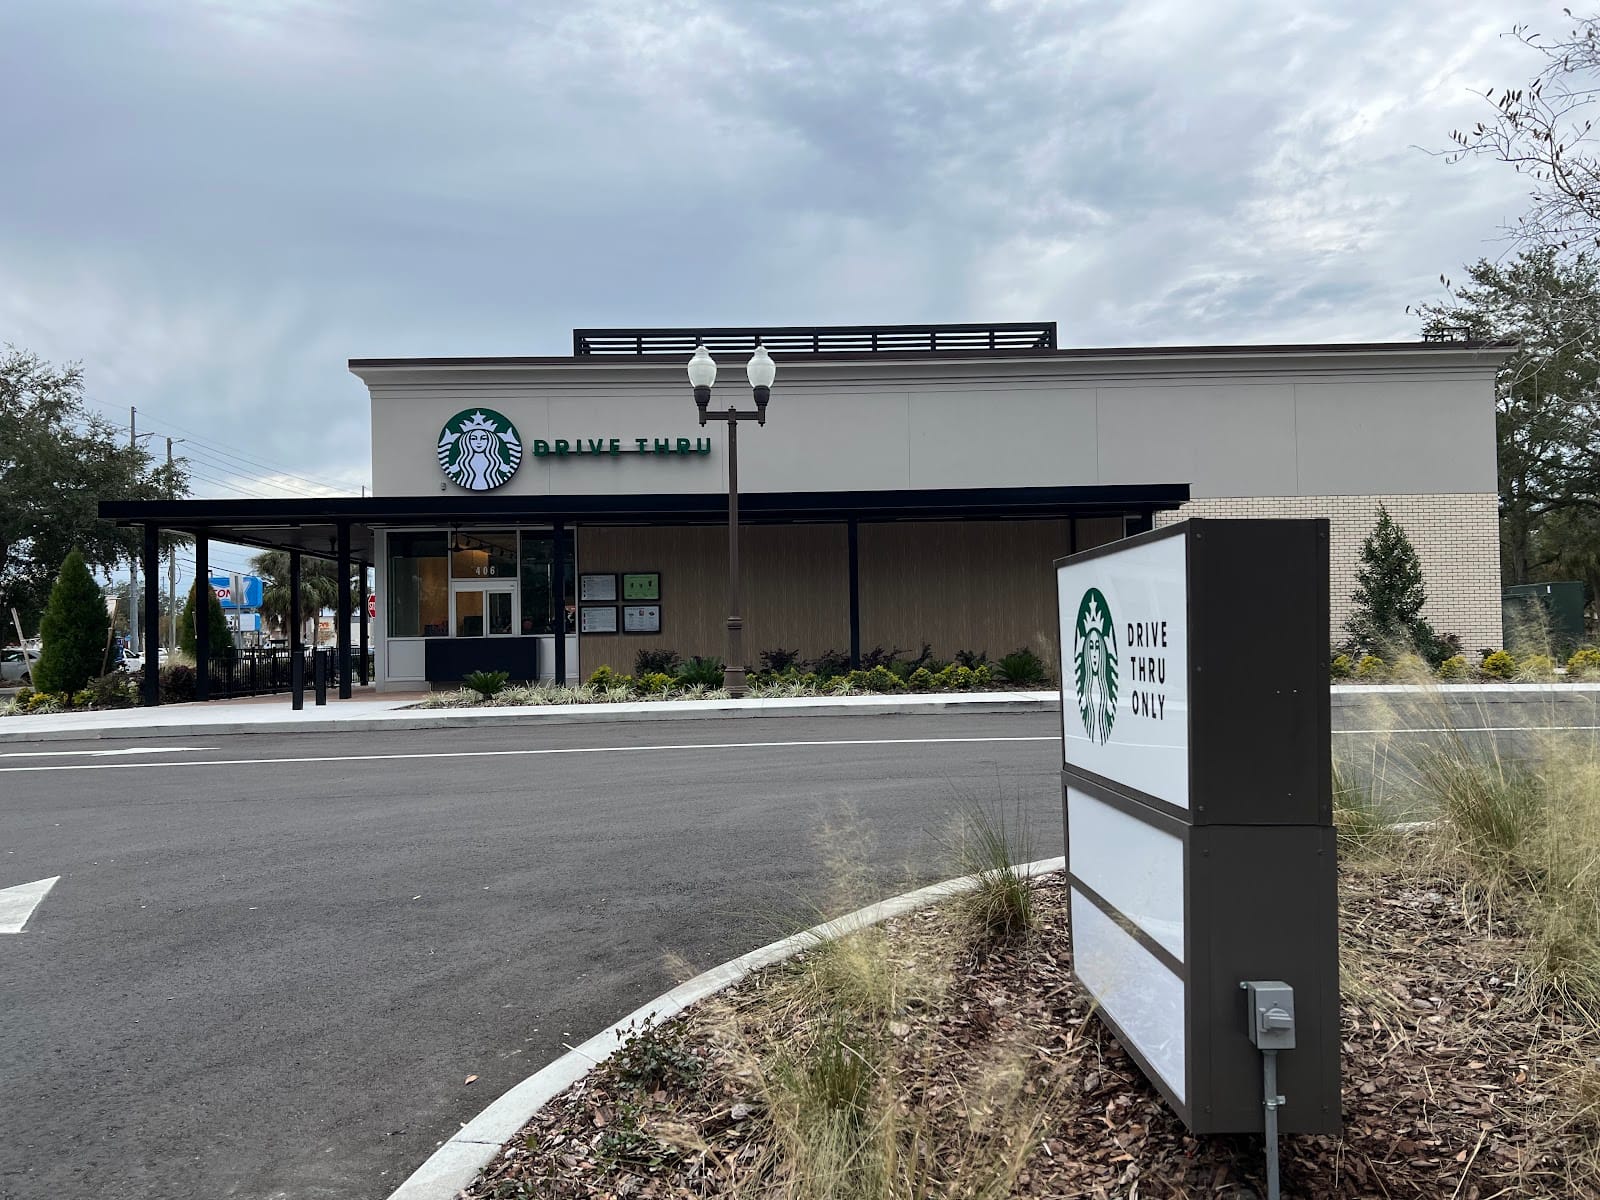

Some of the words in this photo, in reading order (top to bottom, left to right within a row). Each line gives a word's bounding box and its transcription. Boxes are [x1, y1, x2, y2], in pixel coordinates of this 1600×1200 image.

[533, 439, 620, 457] DRIVE
[635, 438, 711, 456] THRU
[475, 566, 495, 576] 406
[1127, 621, 1167, 648] DRIVE
[1130, 656, 1165, 684] THRU
[1132, 690, 1165, 720] ONLY
